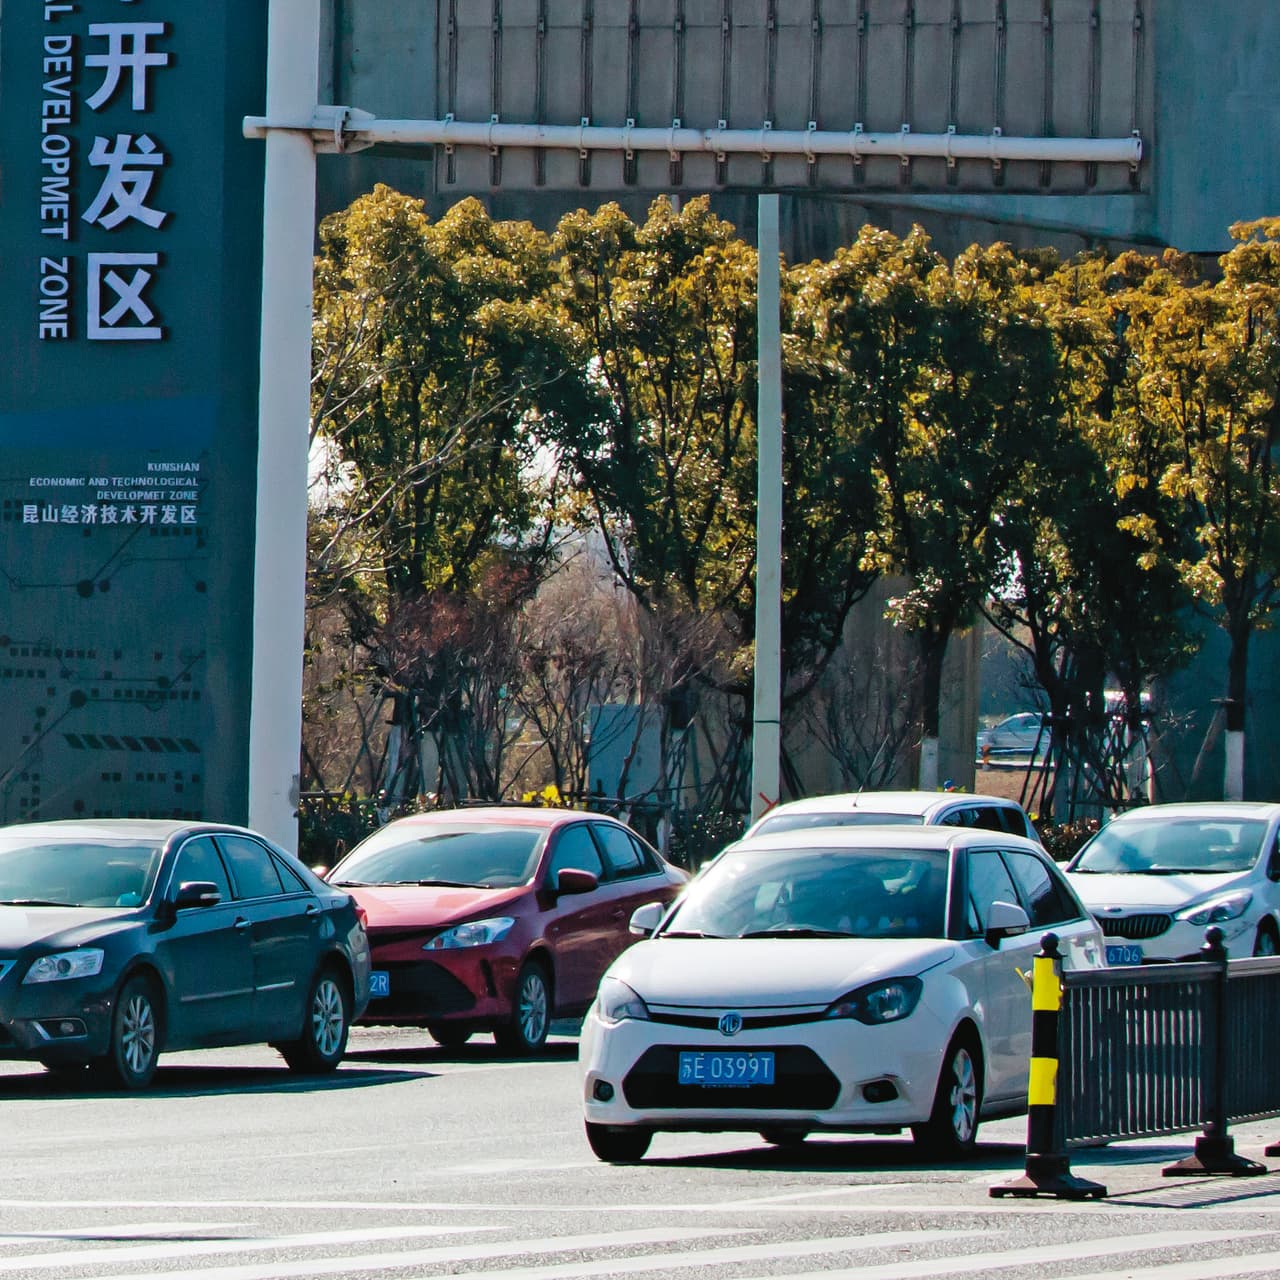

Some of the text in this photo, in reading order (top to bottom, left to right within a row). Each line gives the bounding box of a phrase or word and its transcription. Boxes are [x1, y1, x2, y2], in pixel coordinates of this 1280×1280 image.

[40, 35, 72, 240] DEVELOPMET
[39, 257, 69, 339] ZONE
[147, 462, 200, 472] KUNSHAN
[29, 477, 199, 487] ECONOMIC AND TECHNOLOGICAL
[169, 490, 198, 501] ZONE
[23, 504, 198, 524] 昆山经济技术开发区
